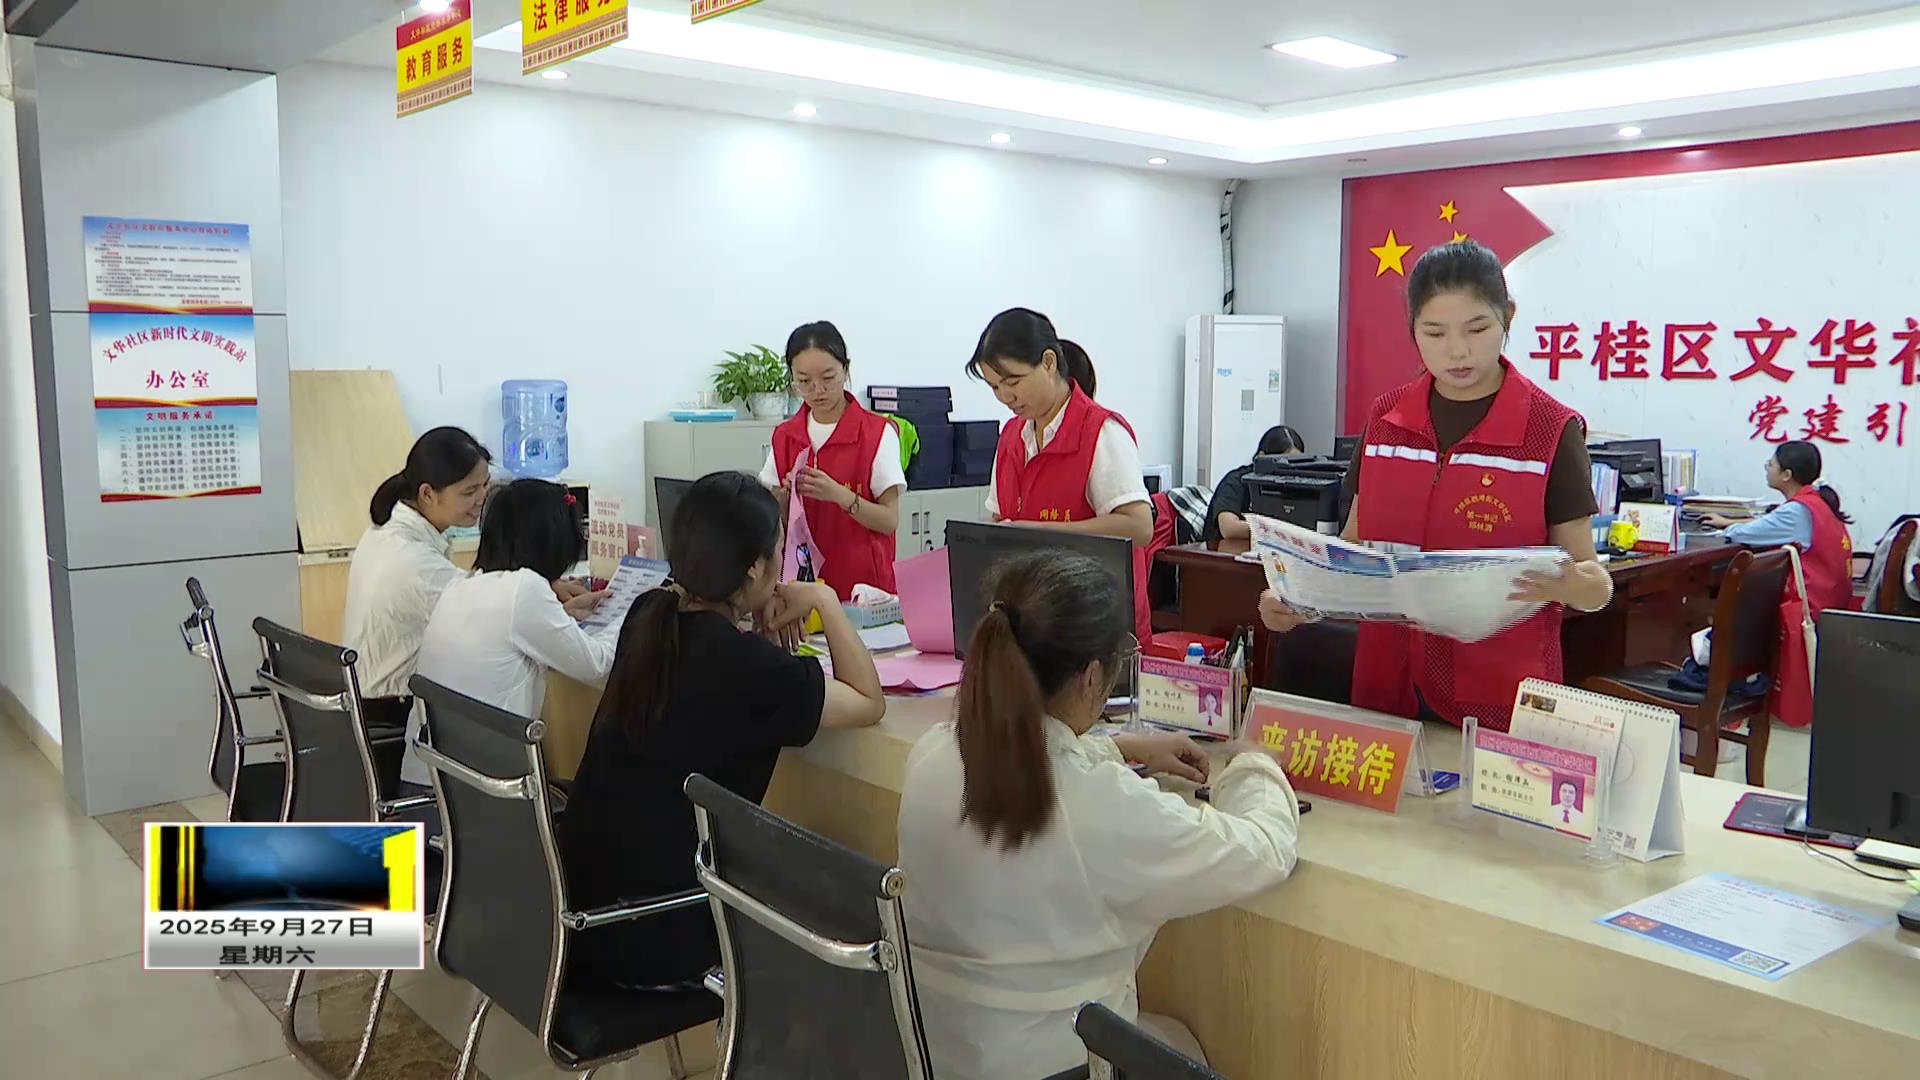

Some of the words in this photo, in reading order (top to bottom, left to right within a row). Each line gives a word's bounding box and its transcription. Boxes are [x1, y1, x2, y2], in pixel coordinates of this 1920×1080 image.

[533, 0, 611, 33] 法律服
[405, 35, 464, 83] 教育服务
[102, 325, 248, 363] 文华社区新时代文明实践站
[146, 370, 210, 389] 办公室
[1747, 393, 1908, 448] 党建引
